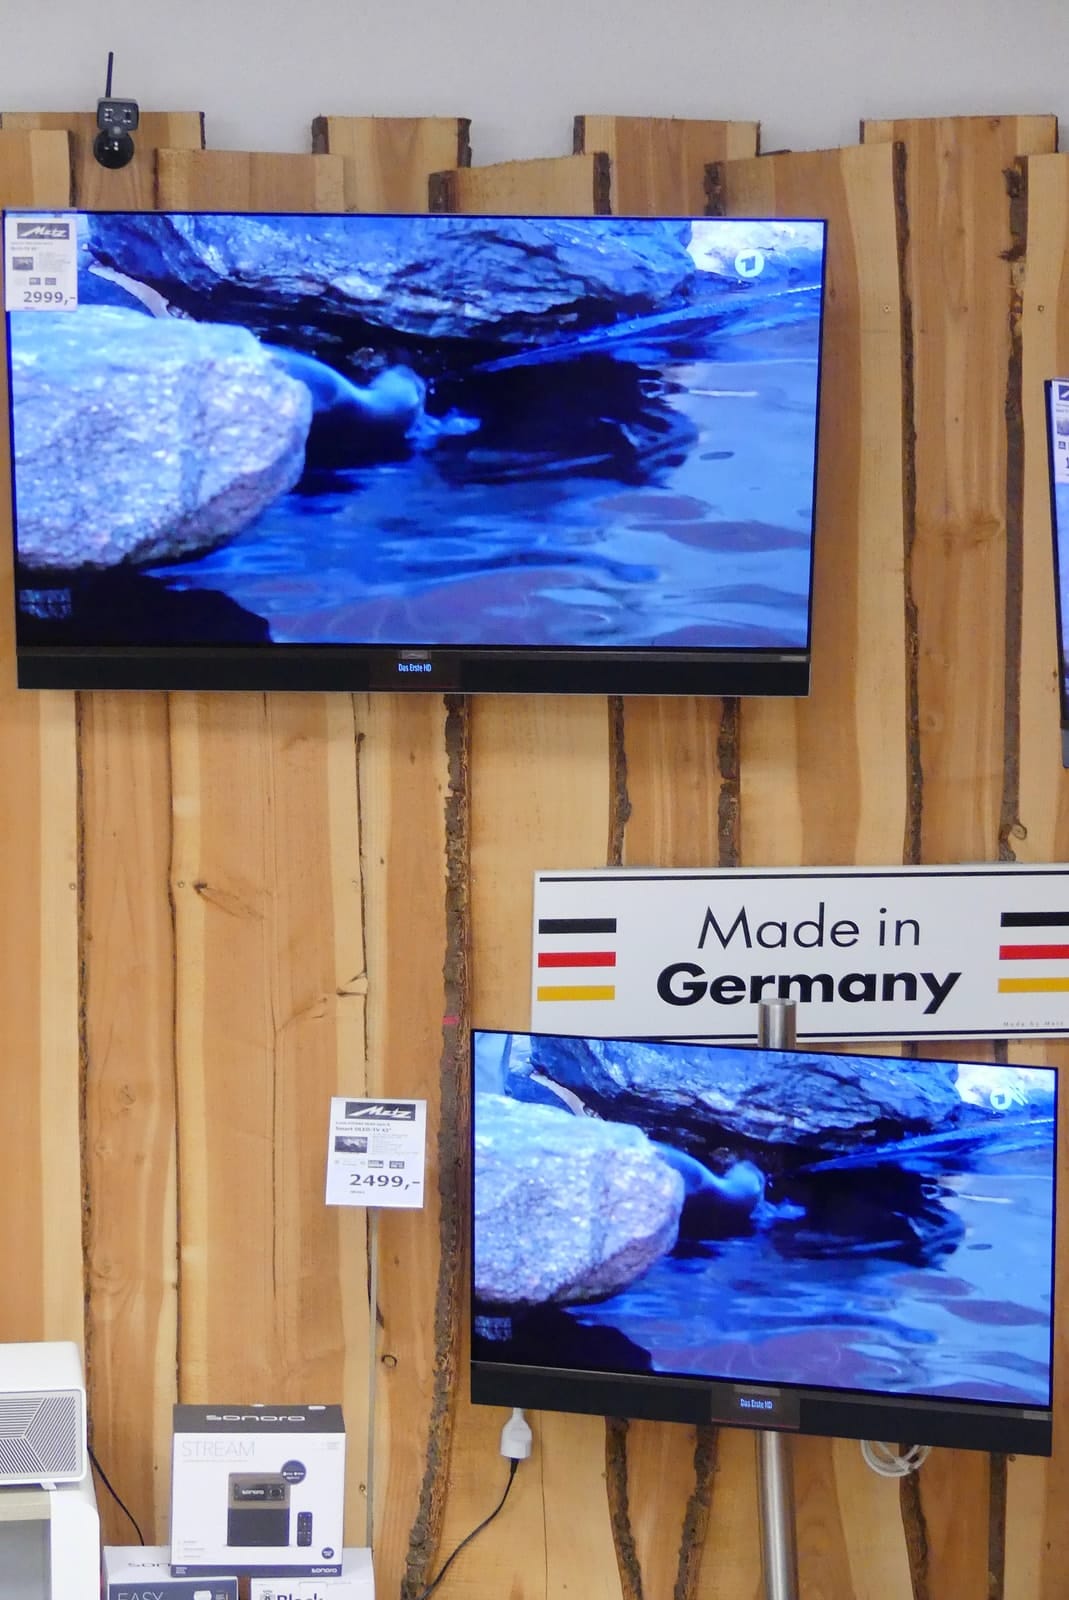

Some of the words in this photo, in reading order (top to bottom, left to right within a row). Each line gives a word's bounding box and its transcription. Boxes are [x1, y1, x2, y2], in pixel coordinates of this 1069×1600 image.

[20, 225, 67, 237] Metz
[398, 663, 409, 672] Das
[409, 663, 423, 672] Erste
[423, 663, 432, 672] HD
[697, 902, 859, 949] Made
[879, 907, 921, 947] in
[656, 962, 963, 1015] Germany
[348, 1105, 412, 1119] Metz
[349, 1173, 421, 1190] 2499,-
[740, 1398, 750, 1407] Das
[205, 1414, 306, 1422] sonoro
[181, 1441, 256, 1457] STREAM
